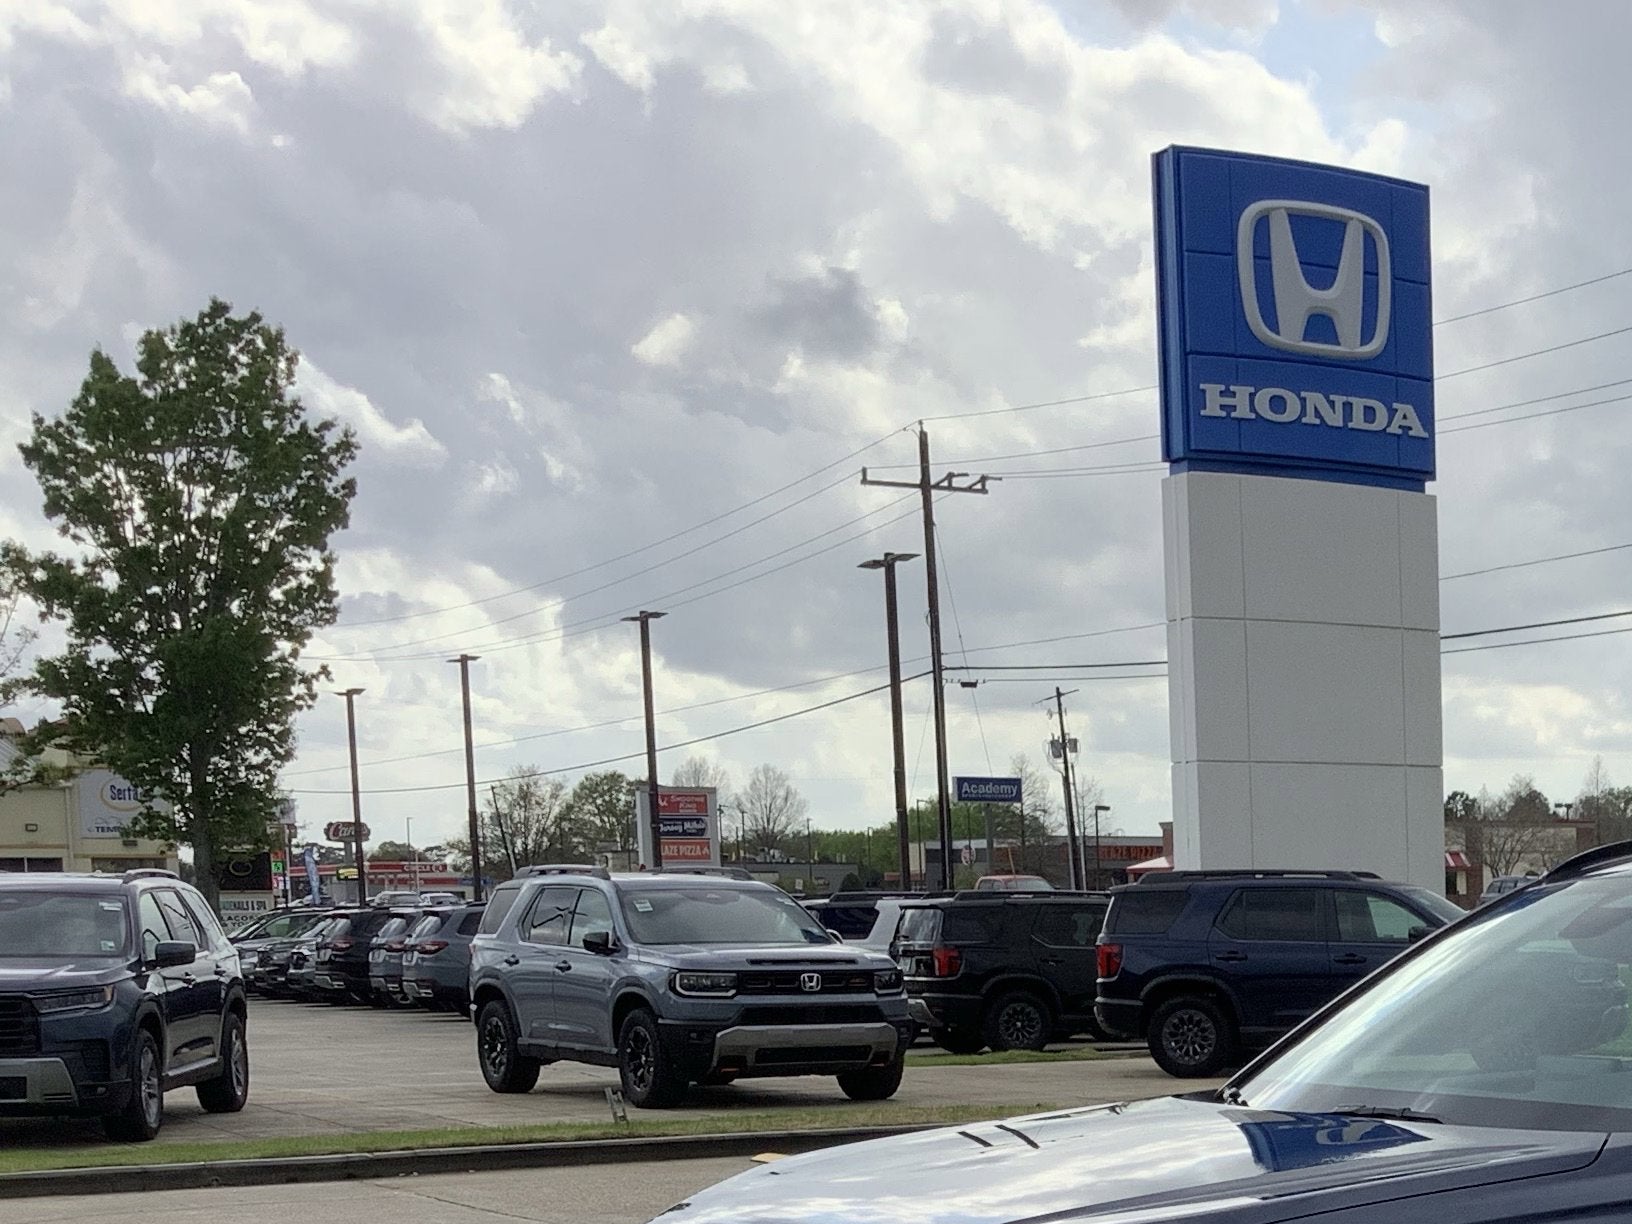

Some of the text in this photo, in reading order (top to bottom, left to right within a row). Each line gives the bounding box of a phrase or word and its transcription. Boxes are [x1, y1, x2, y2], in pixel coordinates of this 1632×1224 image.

[1200, 383, 1429, 439] HONDA
[961, 782, 1018, 797] Academy
[660, 845, 701, 857] LAZE PIZZA
